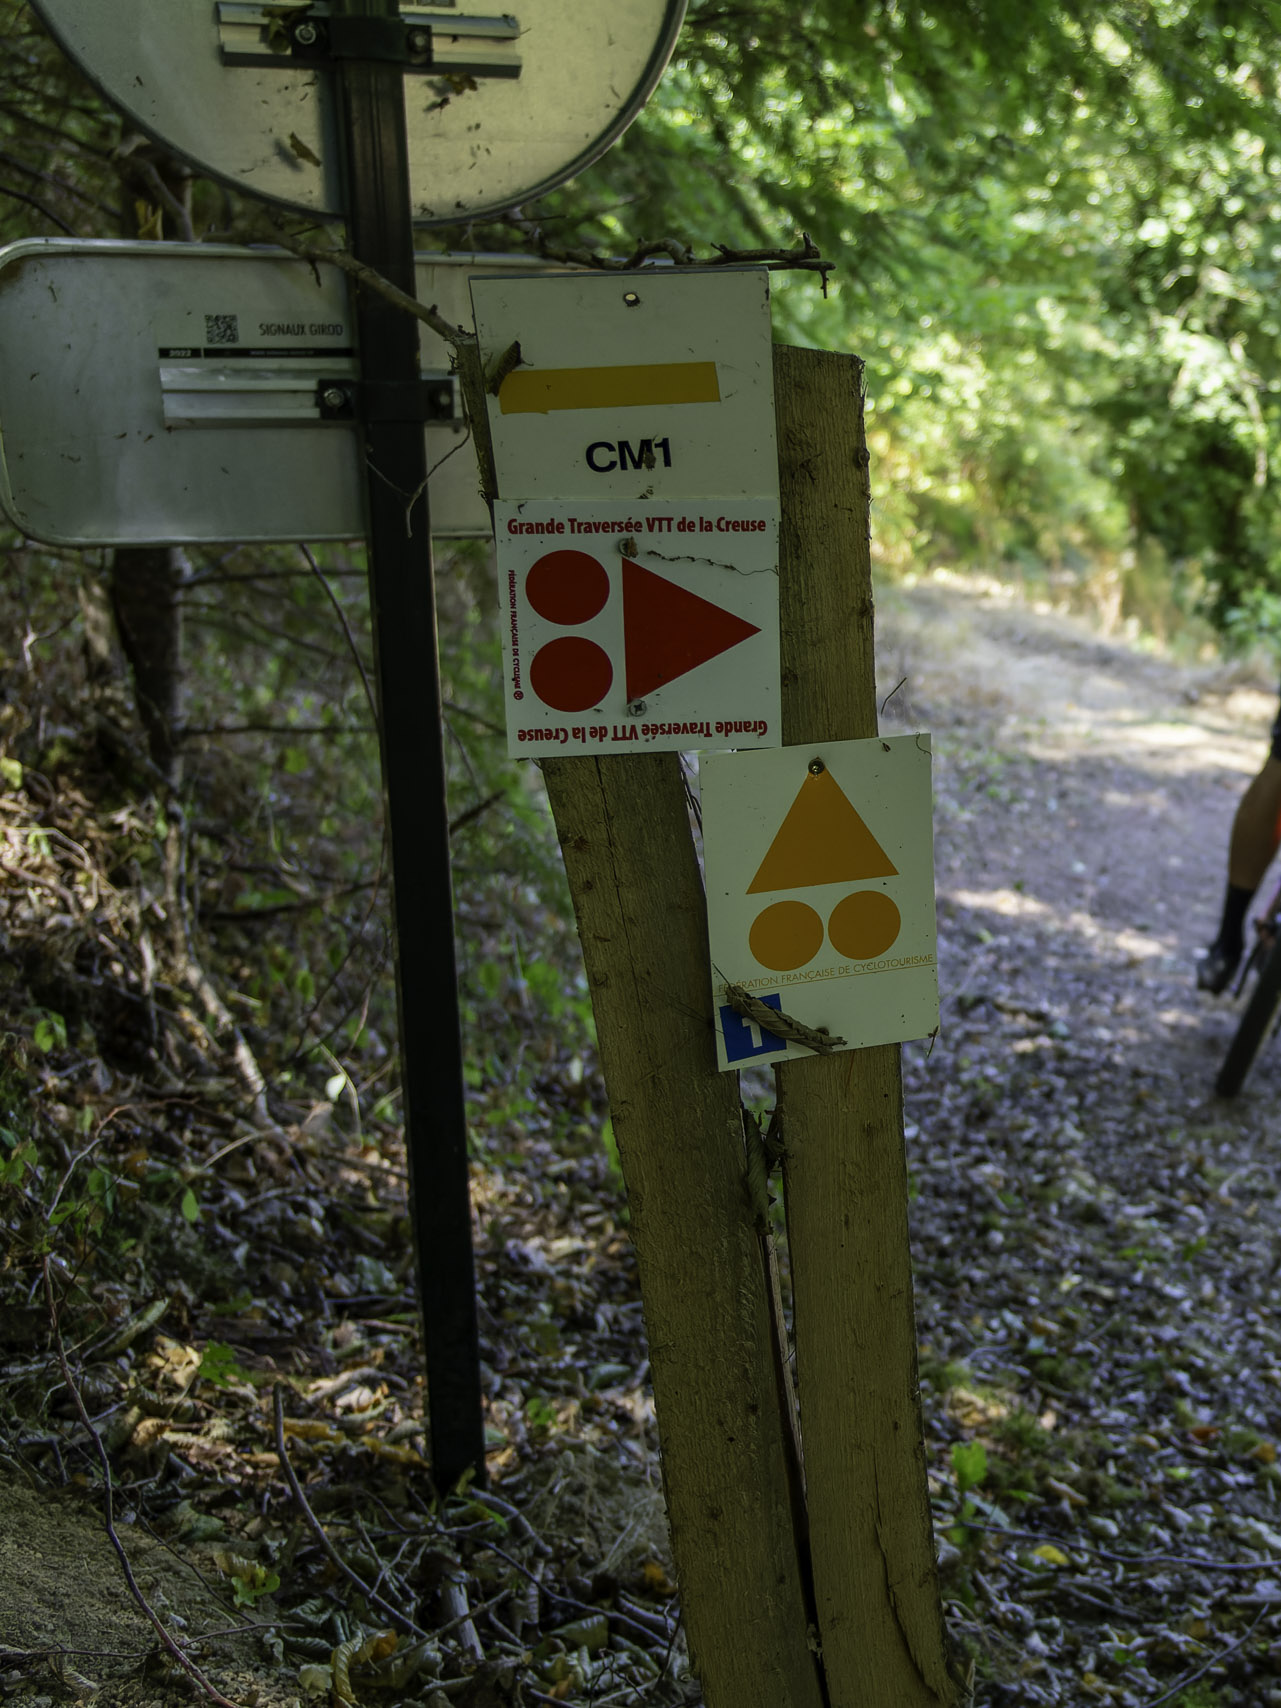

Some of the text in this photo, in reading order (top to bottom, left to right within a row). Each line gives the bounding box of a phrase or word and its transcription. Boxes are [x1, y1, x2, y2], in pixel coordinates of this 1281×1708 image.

[259, 323, 344, 336] SIGNAUX GIROD
[585, 437, 672, 473] CM1
[507, 516, 767, 535] Grande Traversée VTT de la Creuse
[512, 648, 520, 657] DE
[517, 720, 768, 744] Grande Traversée VTT de la Creuse
[781, 967, 835, 983] FRANÇAISE
[838, 965, 851, 976] DE
[853, 953, 934, 974] CYCLOTOURISME
